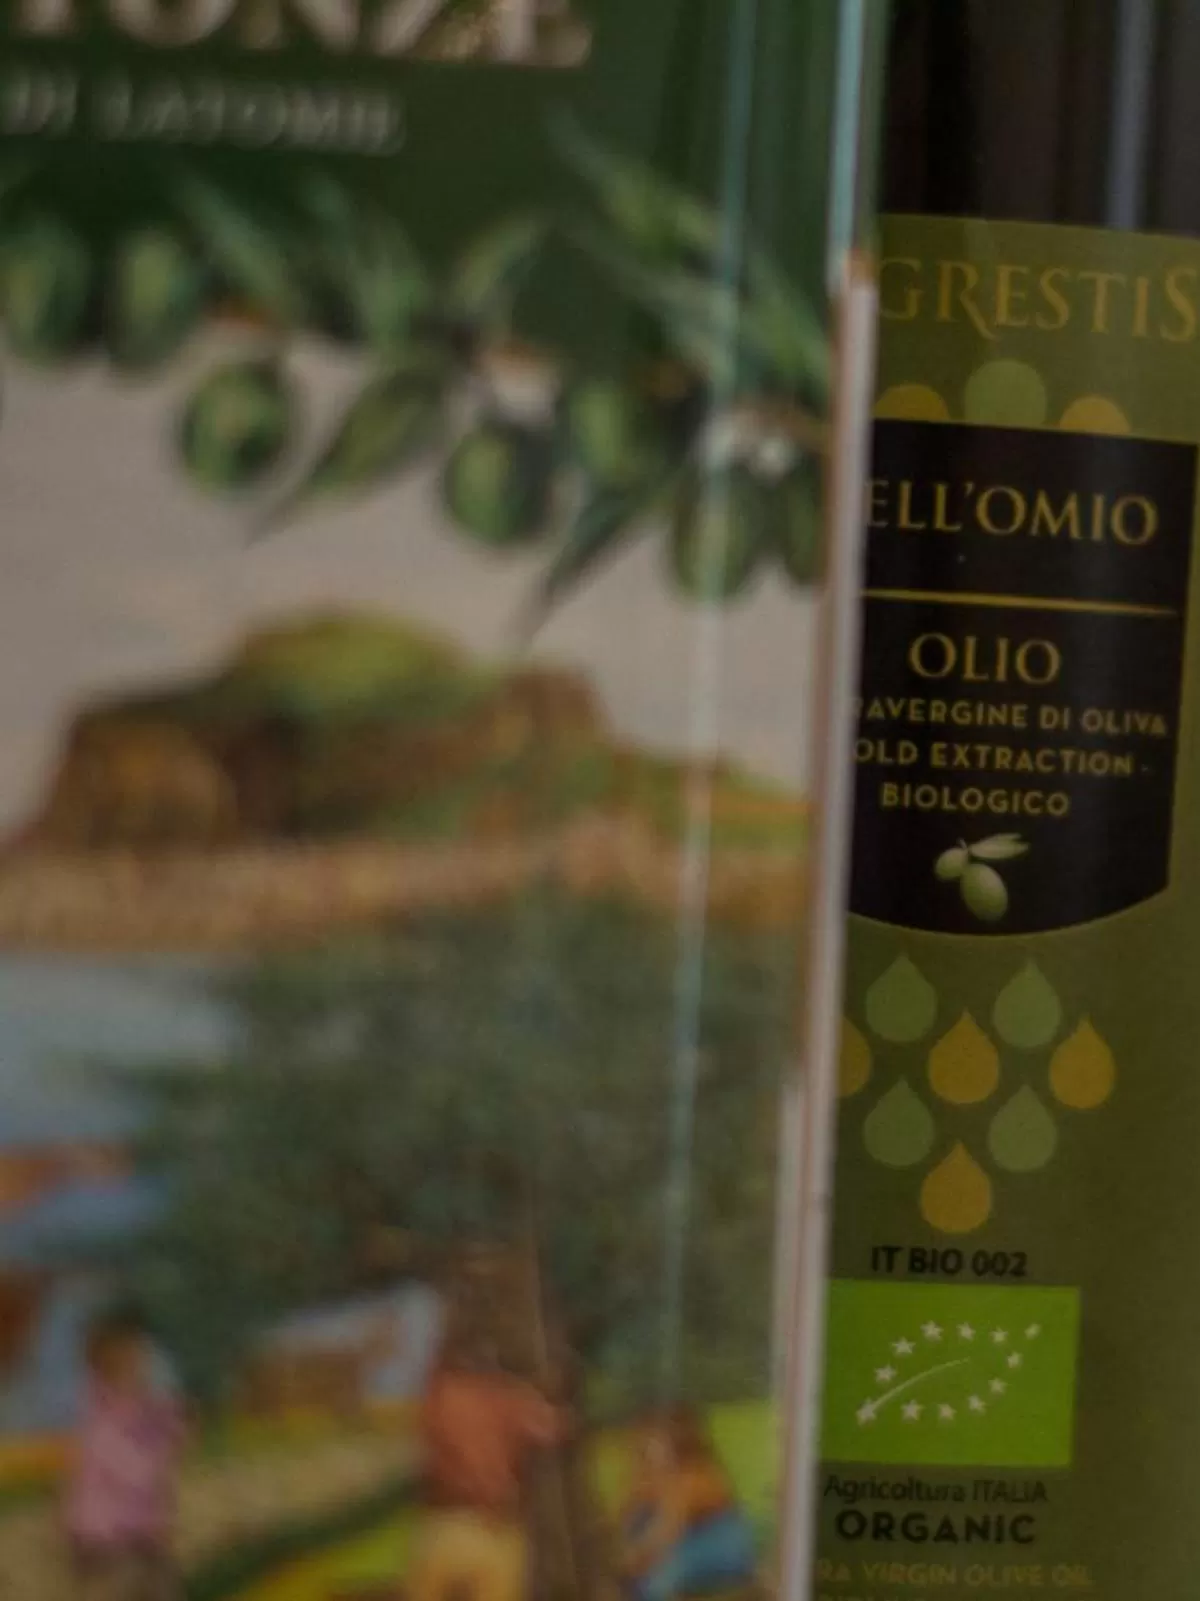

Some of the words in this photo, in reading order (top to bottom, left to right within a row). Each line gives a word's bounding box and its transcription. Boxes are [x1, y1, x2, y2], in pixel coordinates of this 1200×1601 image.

[878, 257, 1200, 343] GRESTIS
[866, 479, 1160, 546] ELL'OMIO
[909, 631, 1062, 686] OLIO
[858, 696, 1028, 730] AVERGINE
[1040, 705, 1070, 732] DI
[1081, 708, 1169, 738] OLIVA
[854, 738, 919, 765] OLD
[930, 741, 1135, 777] EXTRACTION
[881, 782, 1070, 816] BIOLOGICO
[871, 1245, 902, 1274] IT
[909, 1247, 964, 1276] BIO
[972, 1250, 1029, 1278] 002
[824, 1473, 966, 1505] Agricoltura
[972, 1479, 1049, 1503] ITALIA
[836, 1508, 1039, 1546] ORGANIC
[815, 1557, 851, 1582] RA
[862, 1559, 957, 1587] VIRGIN
[963, 1562, 1046, 1589] OLIVE
